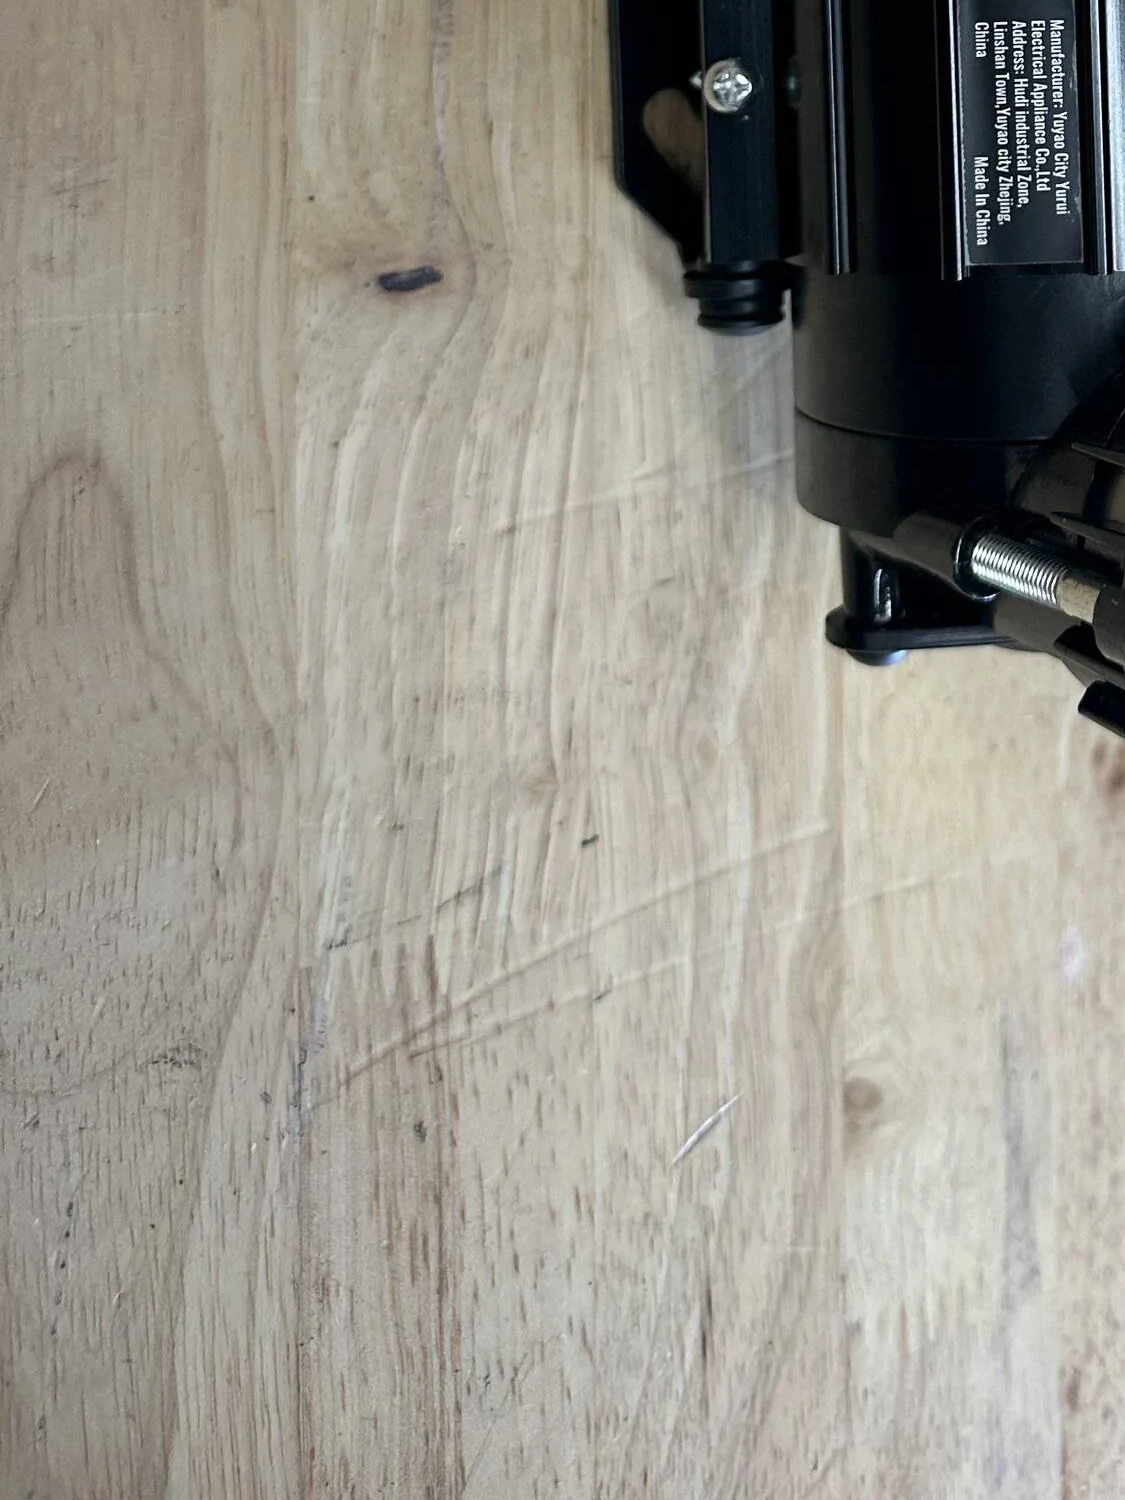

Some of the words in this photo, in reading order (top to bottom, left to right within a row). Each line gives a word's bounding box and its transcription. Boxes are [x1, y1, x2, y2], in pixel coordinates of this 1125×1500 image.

[975, 22, 989, 58] China
[993, 21, 1008, 69] Linshan
[1012, 20, 1027, 75] Address:
[1031, 20, 1047, 79] Electrical
[1049, 20, 1065, 108] Manufacturer:
[994, 73, 1011, 145] Town,Yuyao
[1014, 78, 1029, 107] Hudi
[1031, 83, 1048, 144] Appliance
[1052, 111, 1067, 149] Yuyao
[1015, 111, 1031, 171] industrial
[974, 156, 989, 190] Made
[996, 149, 1012, 172] city
[1034, 148, 1050, 192] Co.,Ltd
[1053, 153, 1069, 178] City
[975, 194, 990, 206] In
[1016, 175, 1032, 208] Zone,
[1055, 181, 1070, 215] Yurui
[975, 210, 991, 246] China
